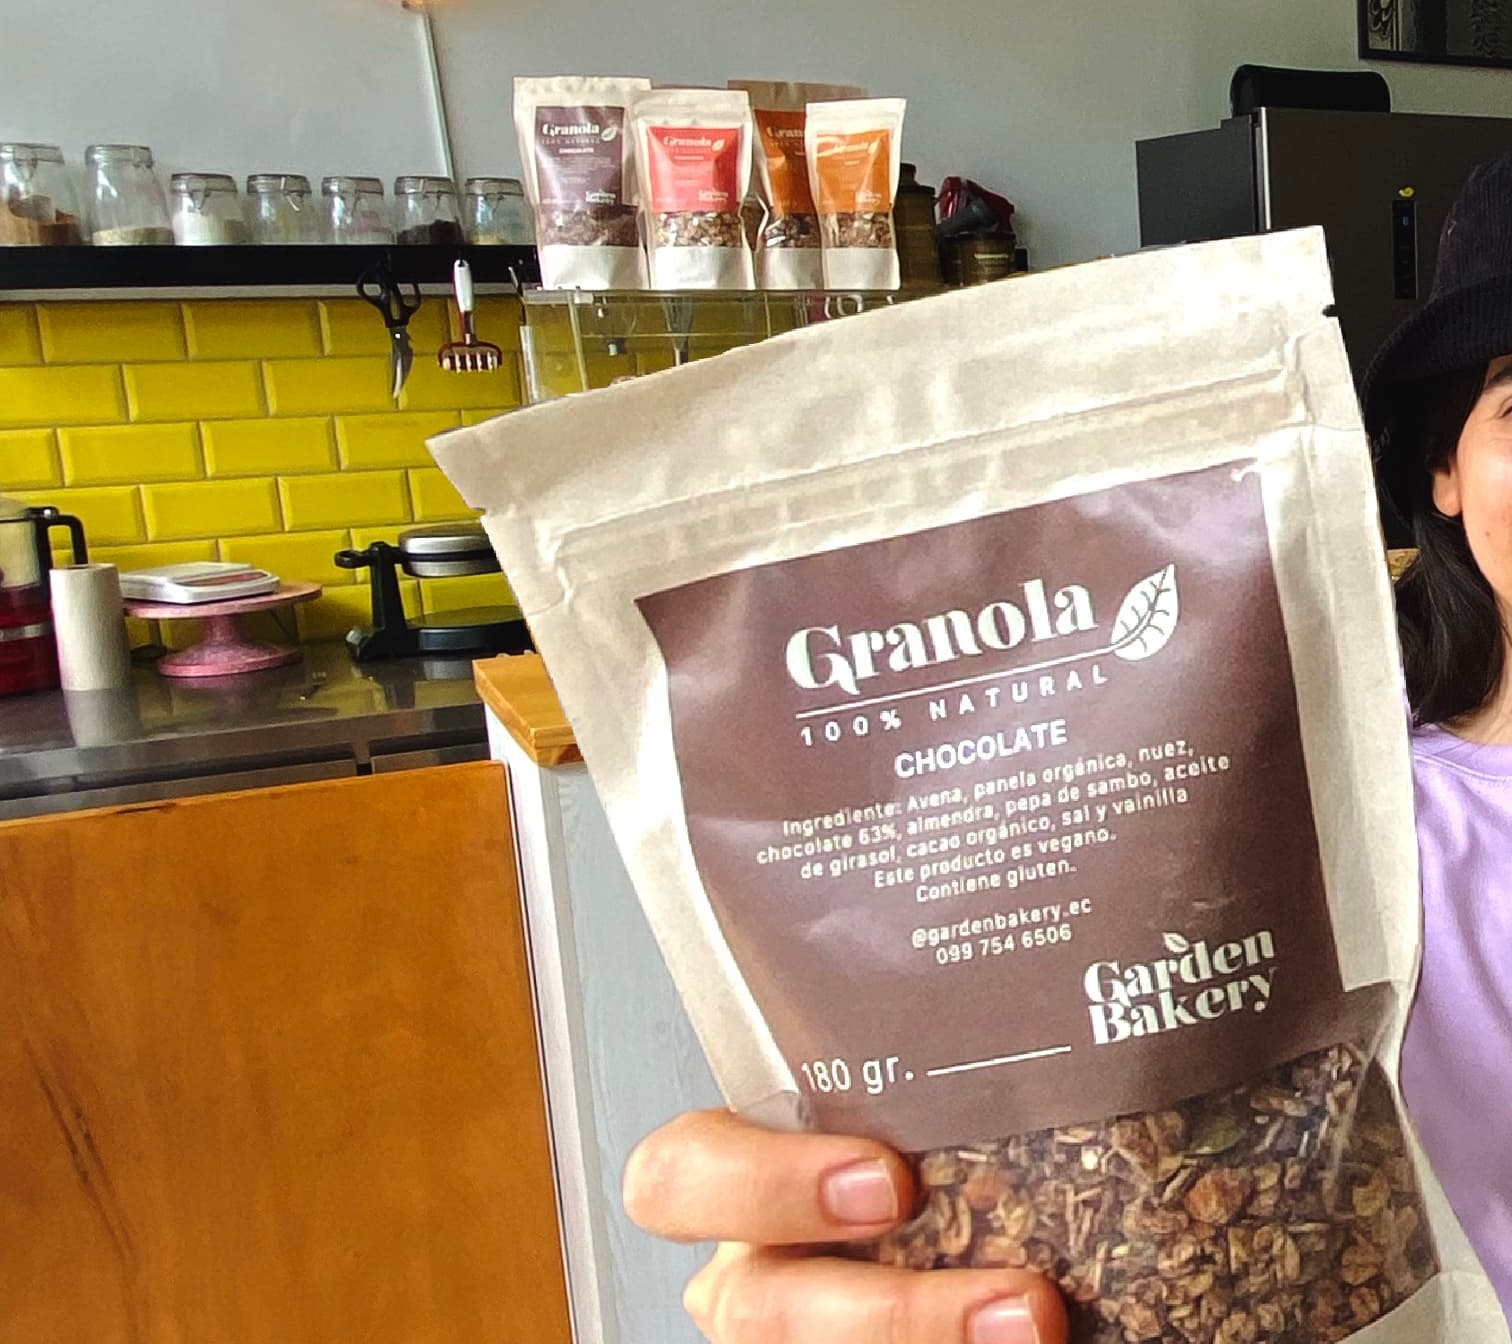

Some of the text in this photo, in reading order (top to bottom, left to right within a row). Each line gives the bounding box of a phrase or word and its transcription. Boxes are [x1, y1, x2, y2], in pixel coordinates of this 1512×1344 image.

[542, 122, 600, 137] Granola
[785, 576, 1099, 696] Granola
[799, 665, 1108, 747] 100% NATURAL
[894, 719, 1067, 778] CHOCOLATE
[757, 834, 852, 864] chocolate
[1006, 793, 1052, 822] pepa
[1058, 785, 1082, 804] de
[1164, 754, 1229, 782] aceite
[907, 786, 968, 811] Avena,
[974, 771, 1037, 800] panela
[801, 861, 823, 879] de
[906, 835, 961, 857] cacao
[1062, 806, 1091, 826] sal
[1096, 803, 1107, 822] y
[1113, 786, 1188, 816] vainilla
[874, 828, 1117, 888] Este producto es vegano.
[916, 857, 1078, 903] Contiene gluten.
[936, 924, 1072, 965] 099 754 6506
[1082, 929, 1276, 1008] Garden
[1089, 965, 1278, 1046] Bakery
[801, 1056, 914, 1094] 180 gr.
